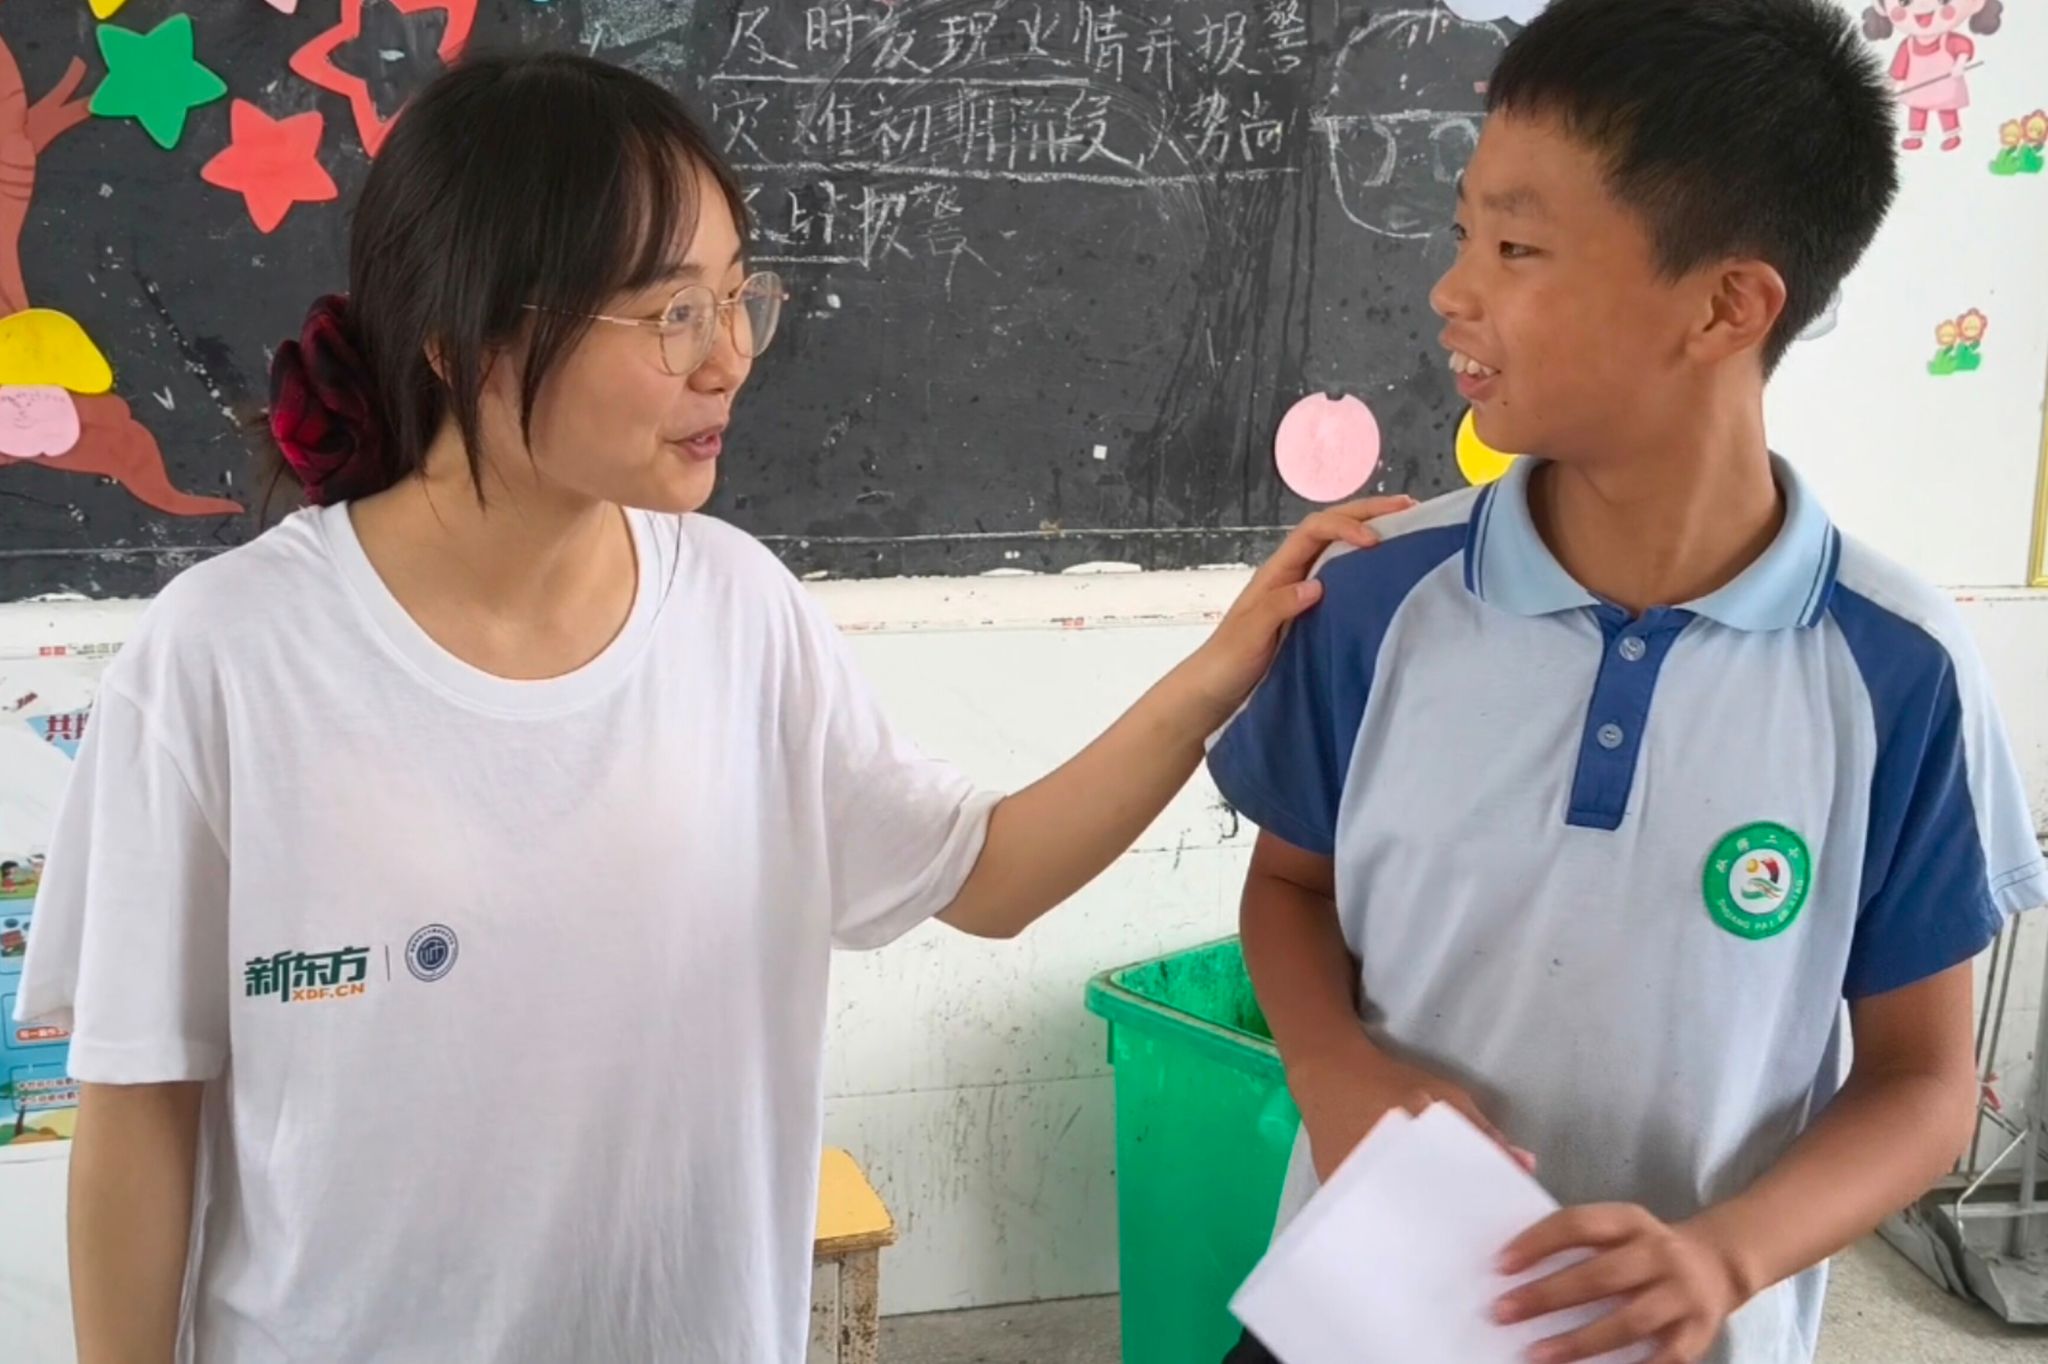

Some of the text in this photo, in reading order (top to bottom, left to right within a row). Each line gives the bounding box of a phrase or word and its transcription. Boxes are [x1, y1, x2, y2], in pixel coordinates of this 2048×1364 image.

[244, 946, 371, 1003] 新东方
[292, 982, 366, 1002] XDF.CN
